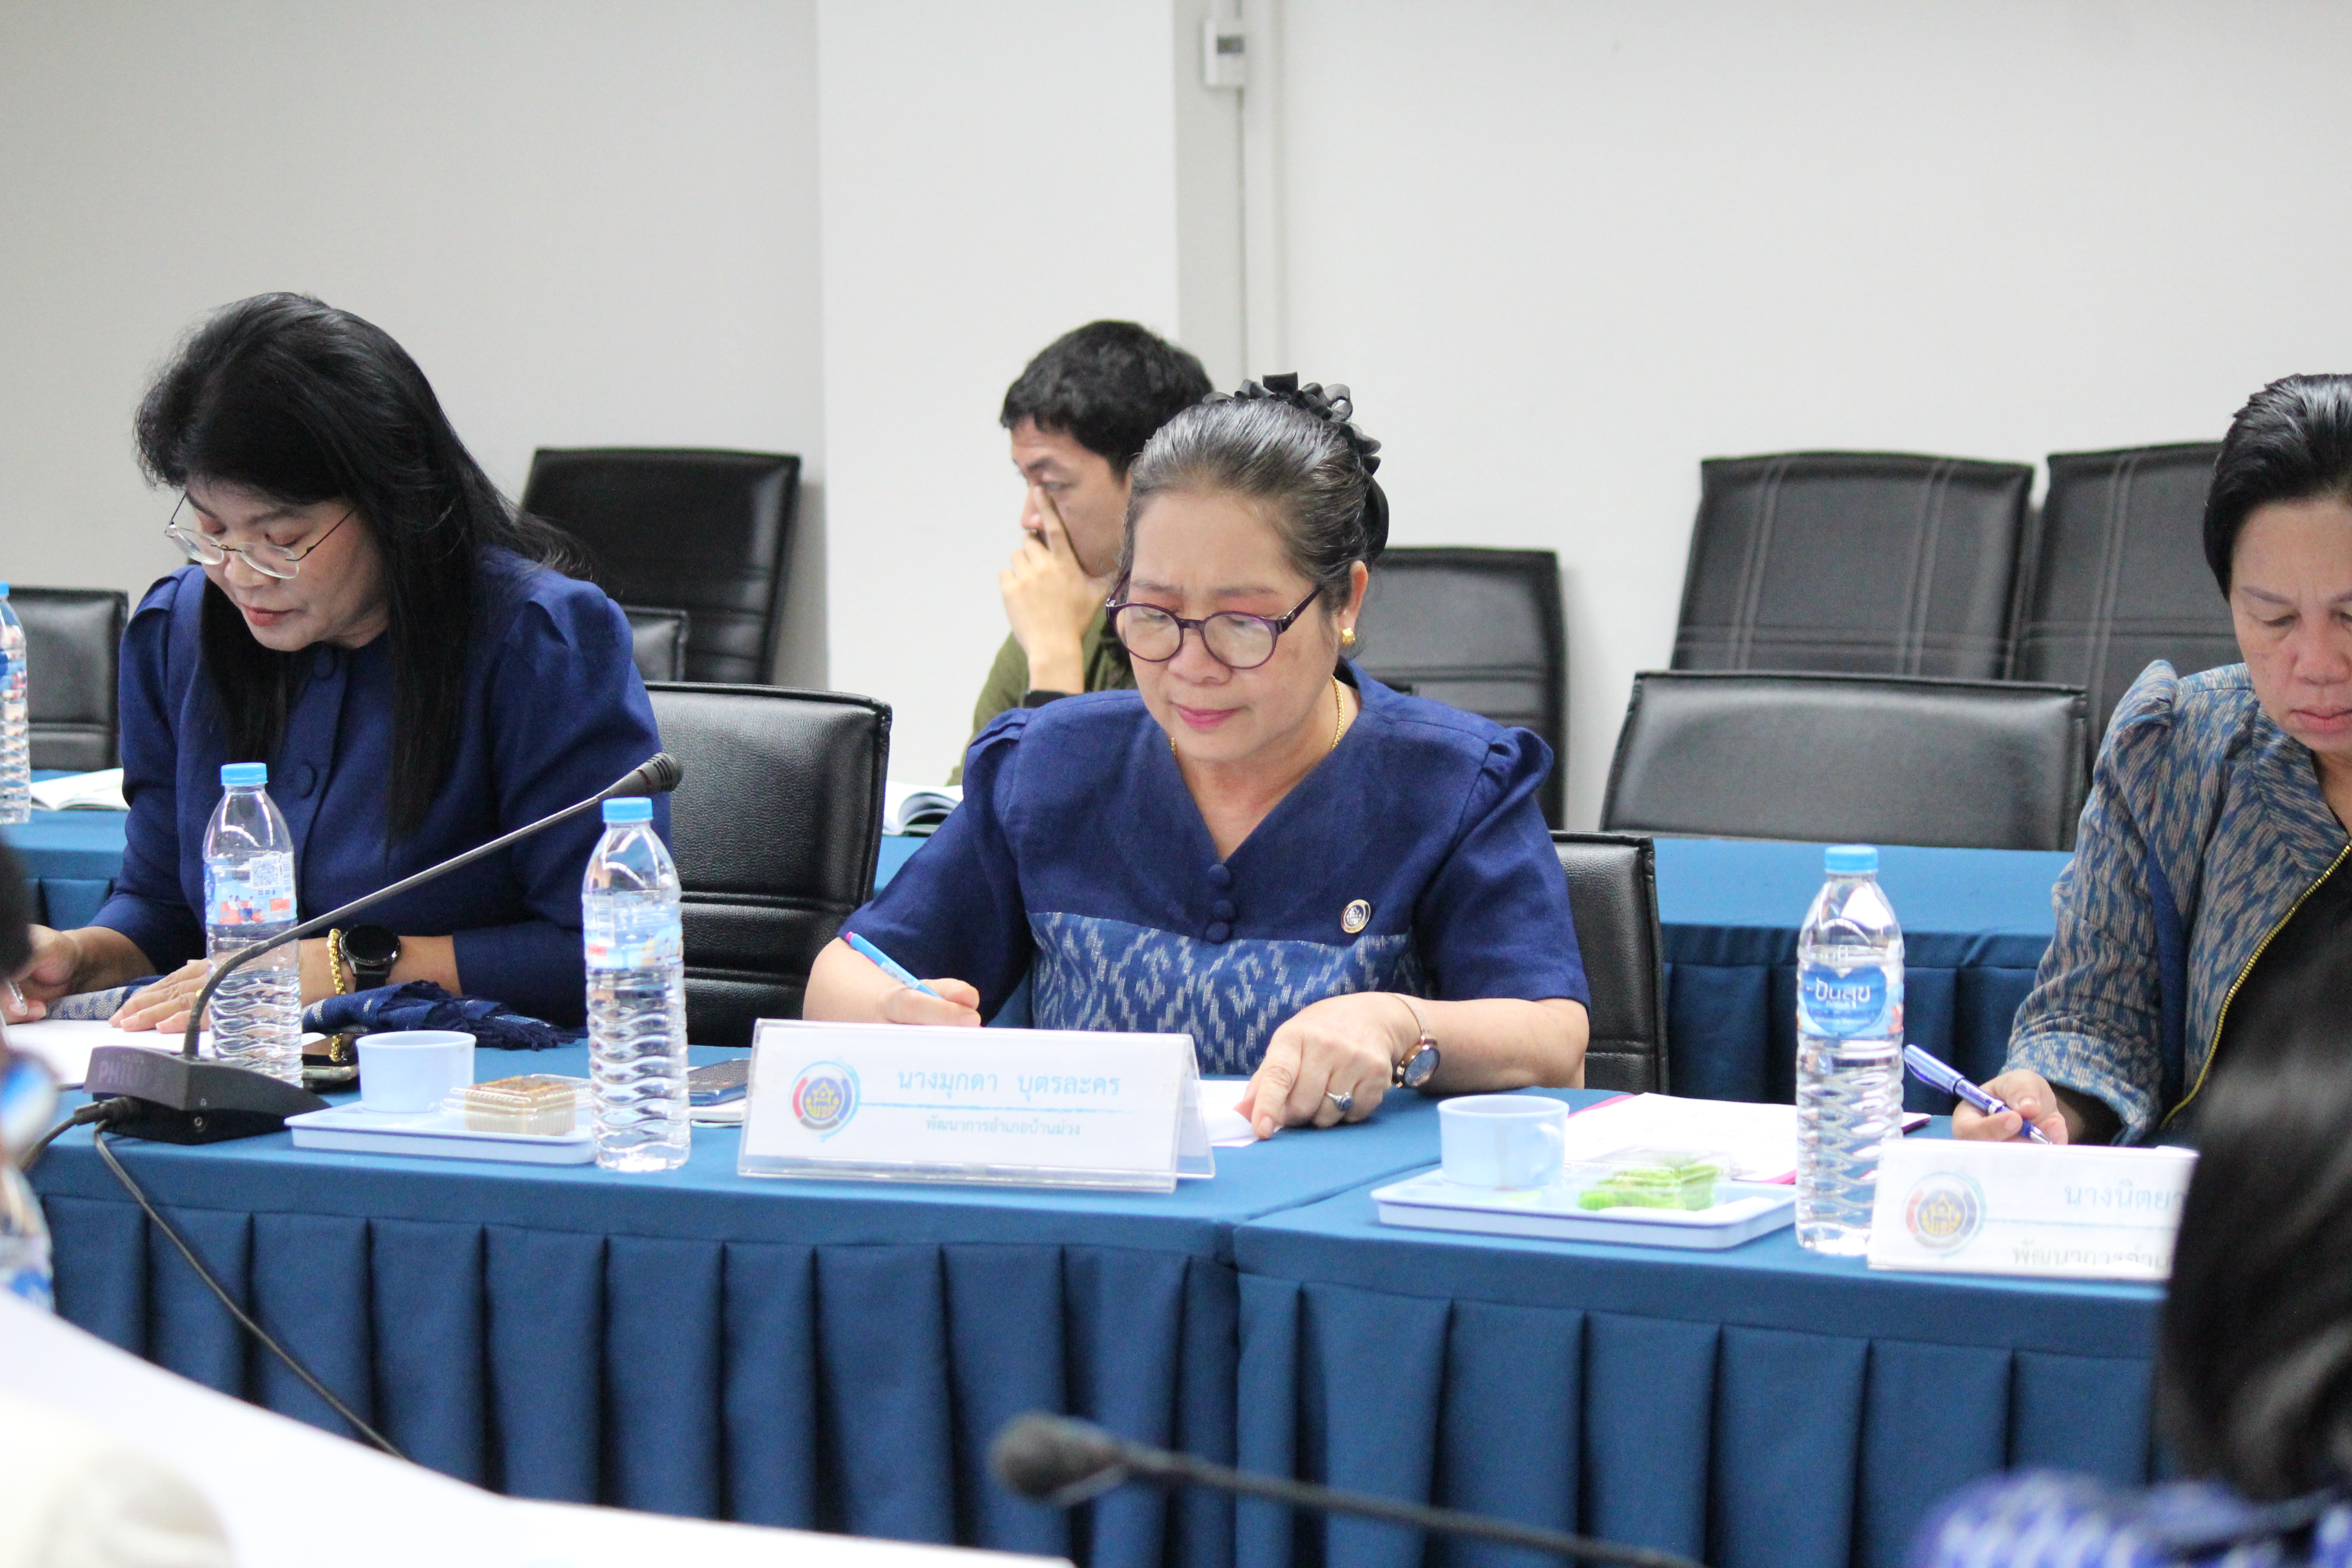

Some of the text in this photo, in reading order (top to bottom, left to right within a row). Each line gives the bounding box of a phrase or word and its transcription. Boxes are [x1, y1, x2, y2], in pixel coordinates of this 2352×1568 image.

[898, 1071, 1122, 1102] นางมุกดา บุตรละคร
[926, 1115, 1081, 1135] พัฒนาการอำเภอบ้านม่วง
